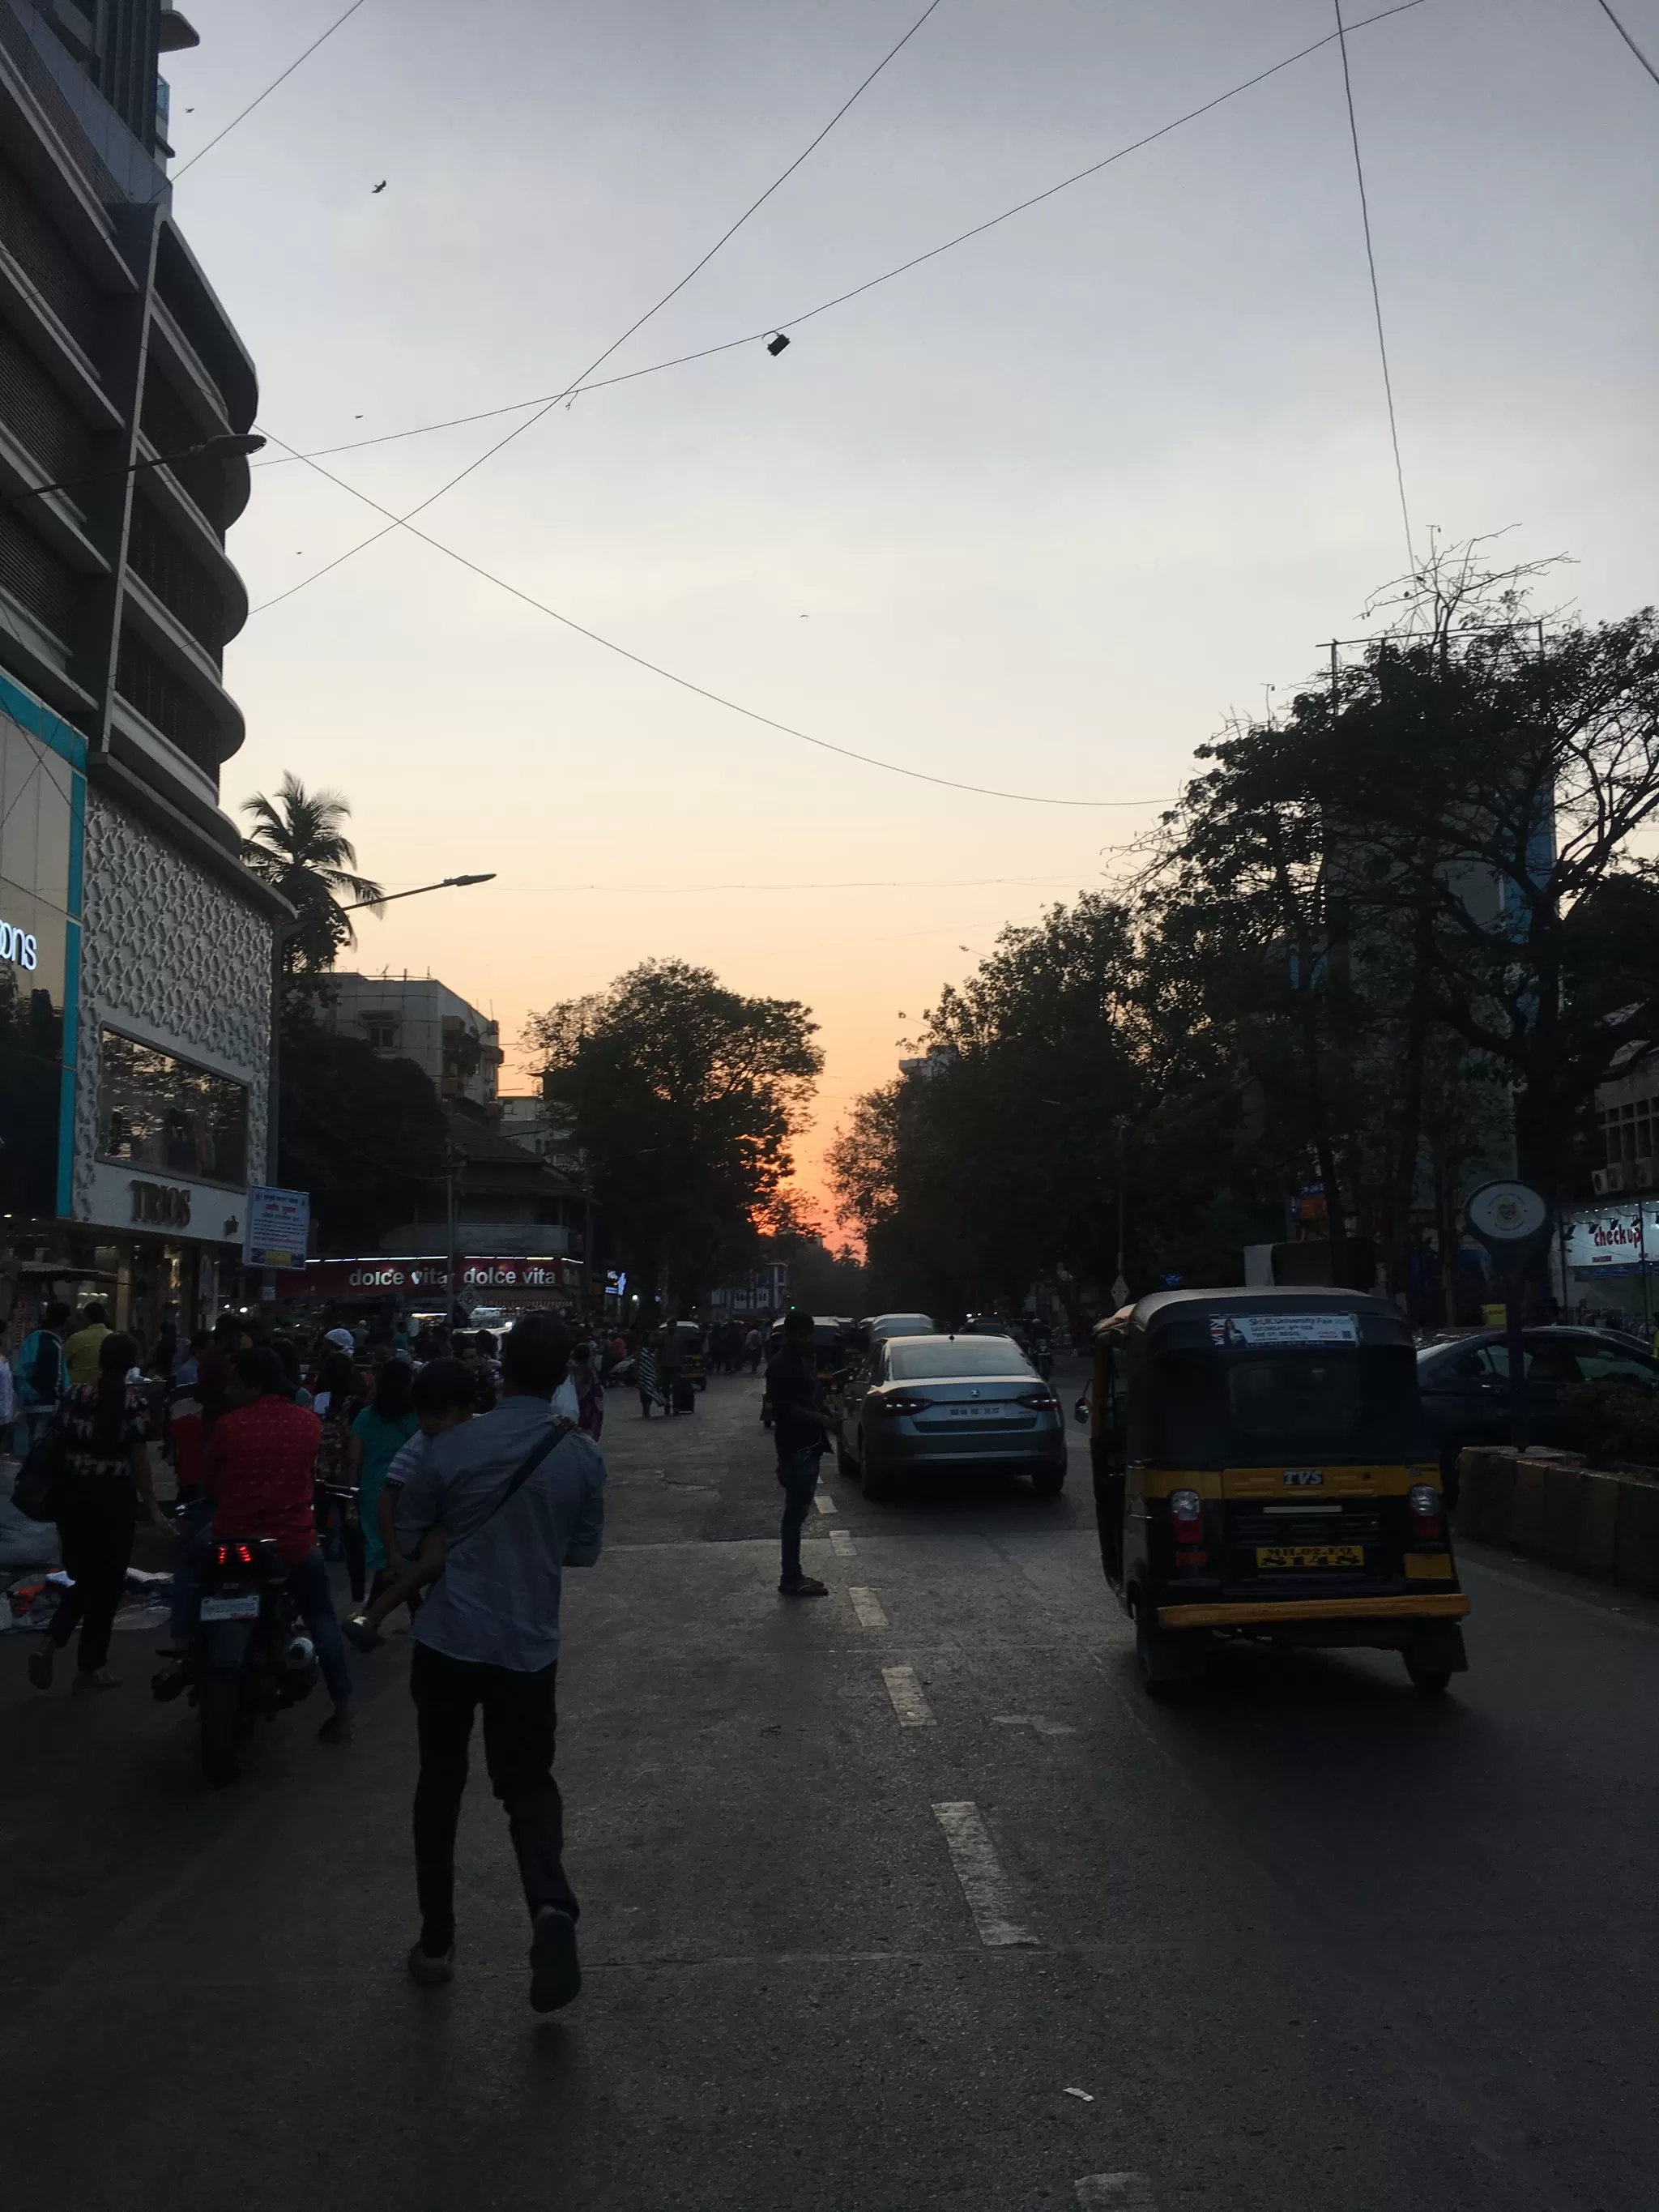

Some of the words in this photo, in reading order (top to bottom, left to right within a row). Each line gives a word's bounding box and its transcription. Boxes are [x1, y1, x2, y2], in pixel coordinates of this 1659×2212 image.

[349, 1266, 405, 1286] dolce
[411, 1267, 449, 1286] vita
[463, 1266, 517, 1285] dolce
[522, 1266, 557, 1285] vita
[1284, 1471, 1324, 1485] TVS
